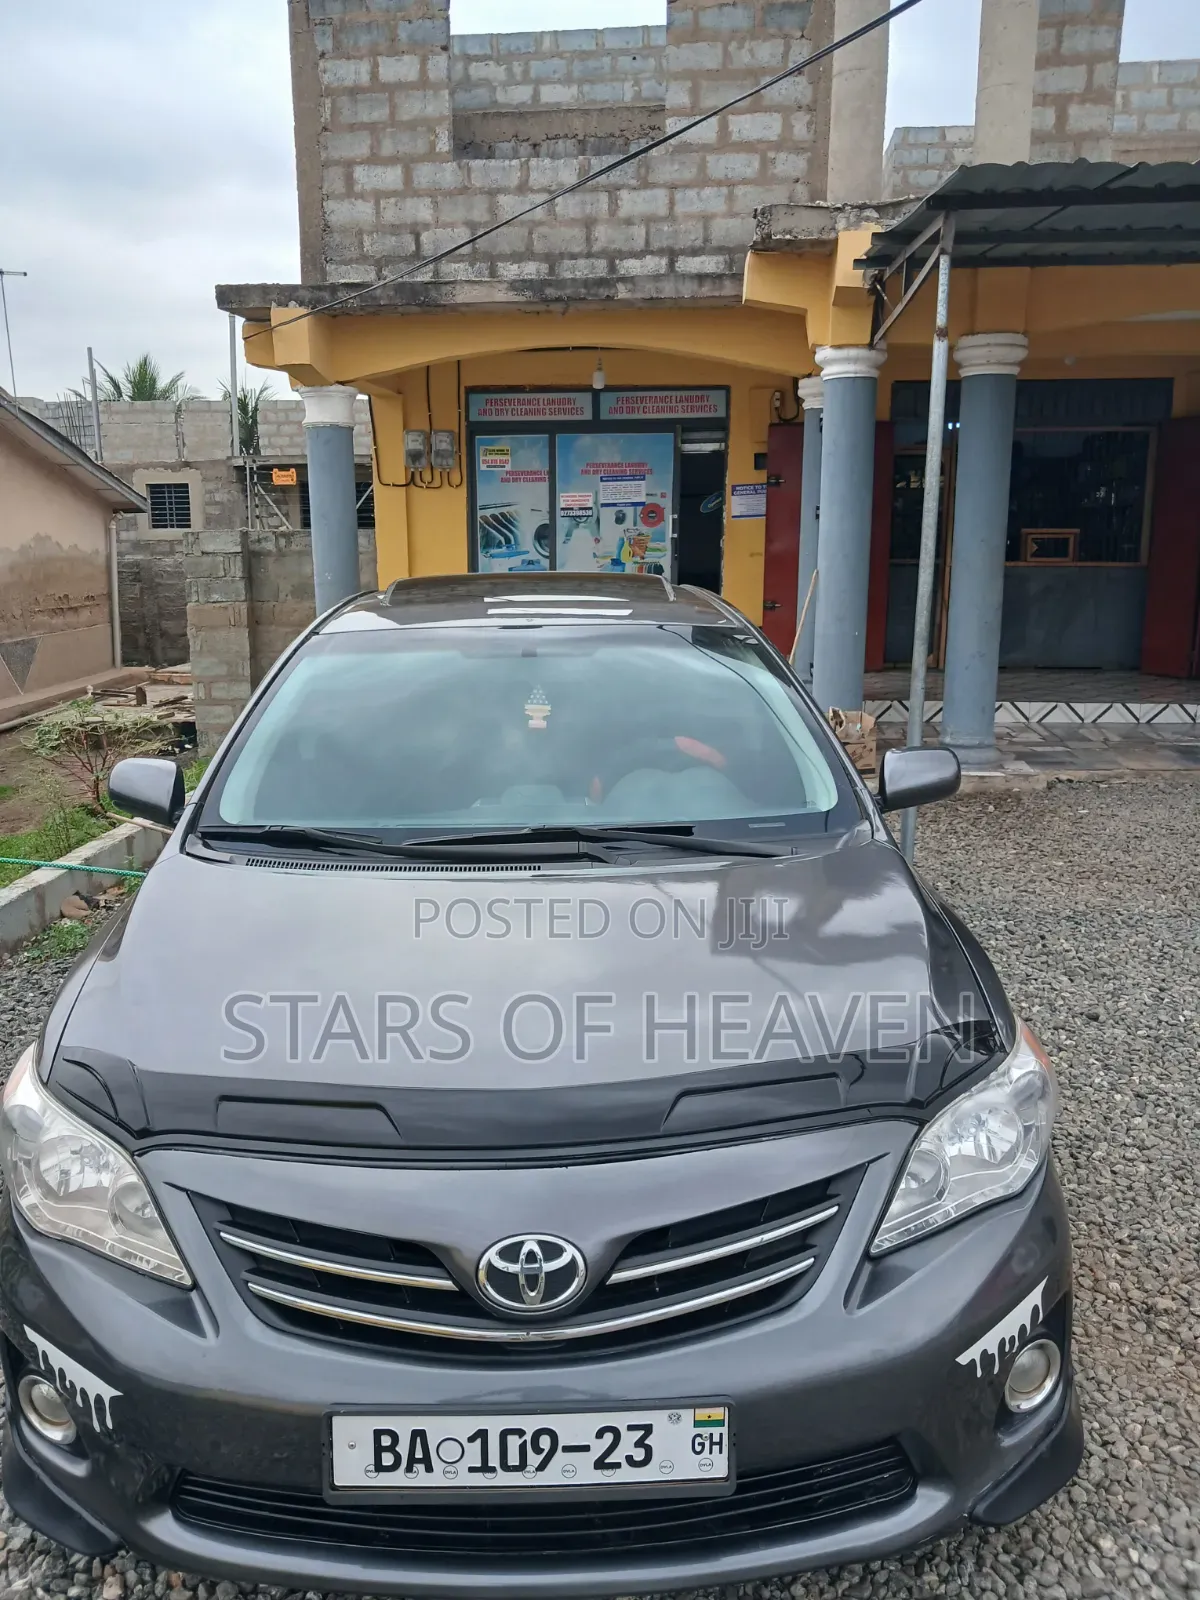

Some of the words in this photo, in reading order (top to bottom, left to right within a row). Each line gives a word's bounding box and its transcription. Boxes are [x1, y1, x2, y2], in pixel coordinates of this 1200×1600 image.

[485, 397, 541, 407] PERSEVERANCE
[616, 395, 674, 405] PERSEVERANCE
[477, 407, 493, 417] AND
[495, 407, 509, 417] DRY
[511, 407, 547, 417] CLEANING
[548, 406, 585, 416] SERVICES
[608, 406, 624, 415] AND
[625, 405, 641, 415] DRY
[642, 405, 679, 415] CLEANING
[680, 404, 718, 414] SERVICES
[691, 1432, 724, 1456] GH
[372, 1427, 434, 1474] BA
